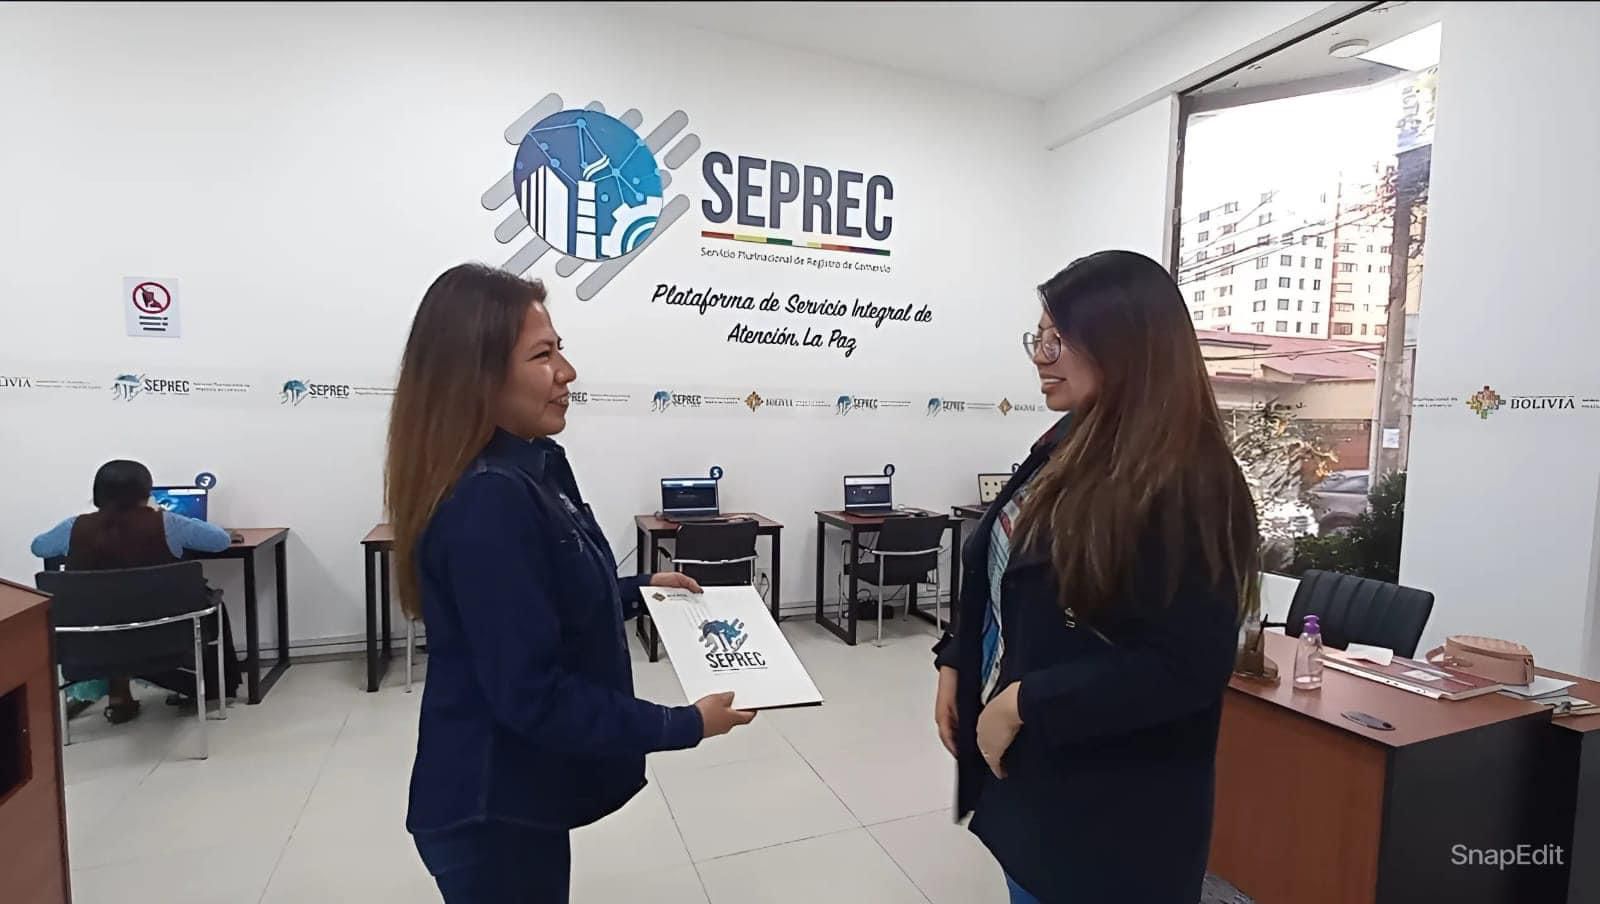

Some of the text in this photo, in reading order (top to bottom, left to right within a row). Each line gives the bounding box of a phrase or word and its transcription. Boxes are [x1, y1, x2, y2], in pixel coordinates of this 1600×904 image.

[701, 151, 894, 241] SEPREC
[700, 247, 736, 259] Servicio
[651, 283, 933, 329] Plataforma de Servicio Integral de
[802, 327, 824, 347] La
[827, 328, 857, 358] Paz
[309, 384, 350, 397] SEPREC
[1511, 398, 1575, 409] BOLIVIA
[705, 651, 766, 669] SEPREC
